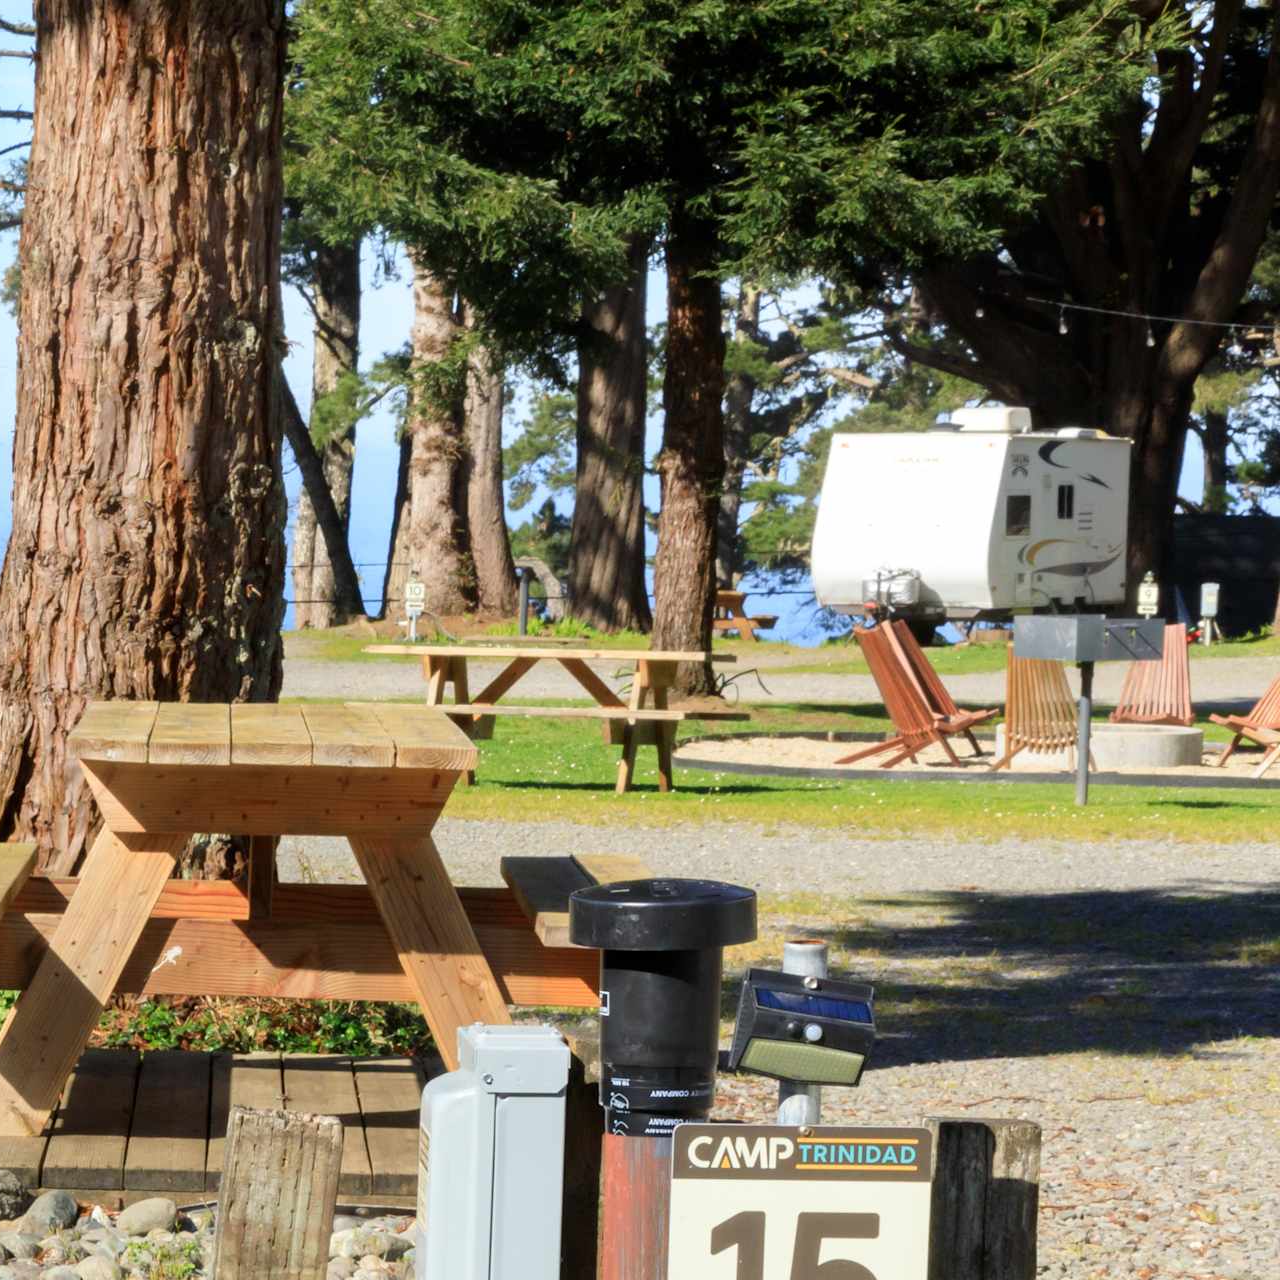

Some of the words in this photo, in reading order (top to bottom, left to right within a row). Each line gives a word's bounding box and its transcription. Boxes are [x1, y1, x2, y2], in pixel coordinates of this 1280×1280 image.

[649, 1090, 689, 1098] COMPANY
[687, 1135, 794, 1170] CAMP
[799, 1144, 916, 1164] TRINIDAD
